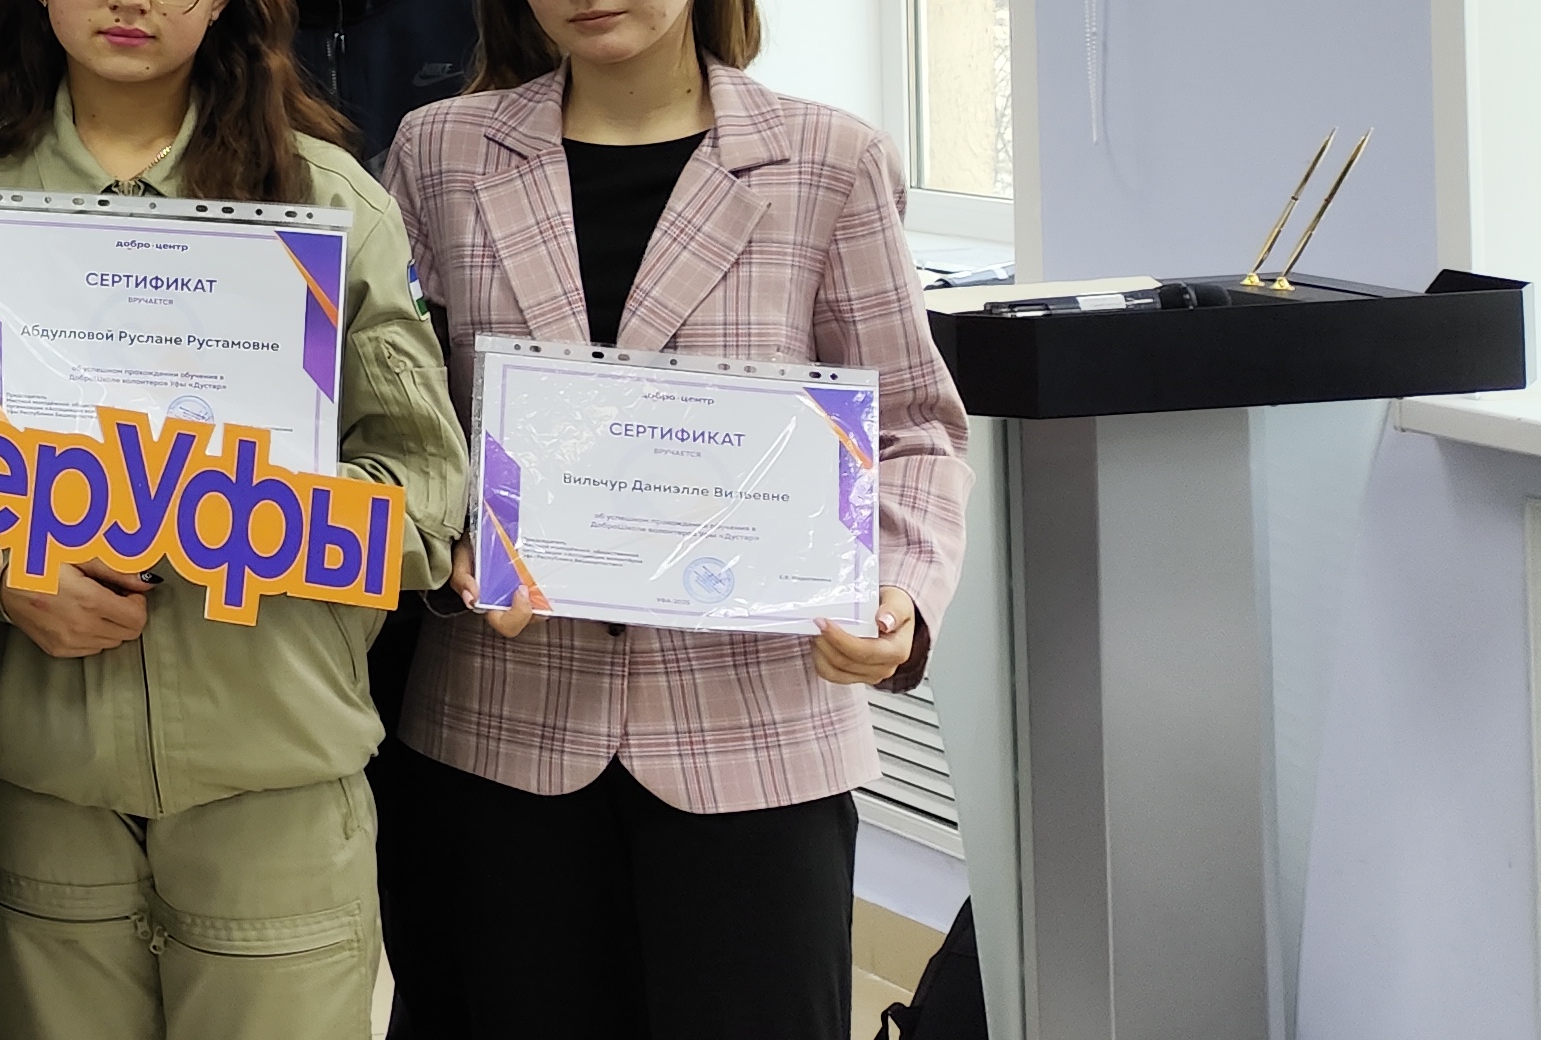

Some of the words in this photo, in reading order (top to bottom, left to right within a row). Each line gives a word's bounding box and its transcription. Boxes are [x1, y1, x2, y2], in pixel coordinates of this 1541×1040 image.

[85, 272, 218, 293] СЕРТИФИКАТ
[20, 324, 114, 342] Абдулловой
[118, 330, 183, 346] Руслане
[187, 334, 280, 352] Рустамовне
[609, 422, 746, 447] СЕРТИФИКАТ
[563, 473, 628, 492] Вильчур
[631, 479, 710, 497] Даниэлле
